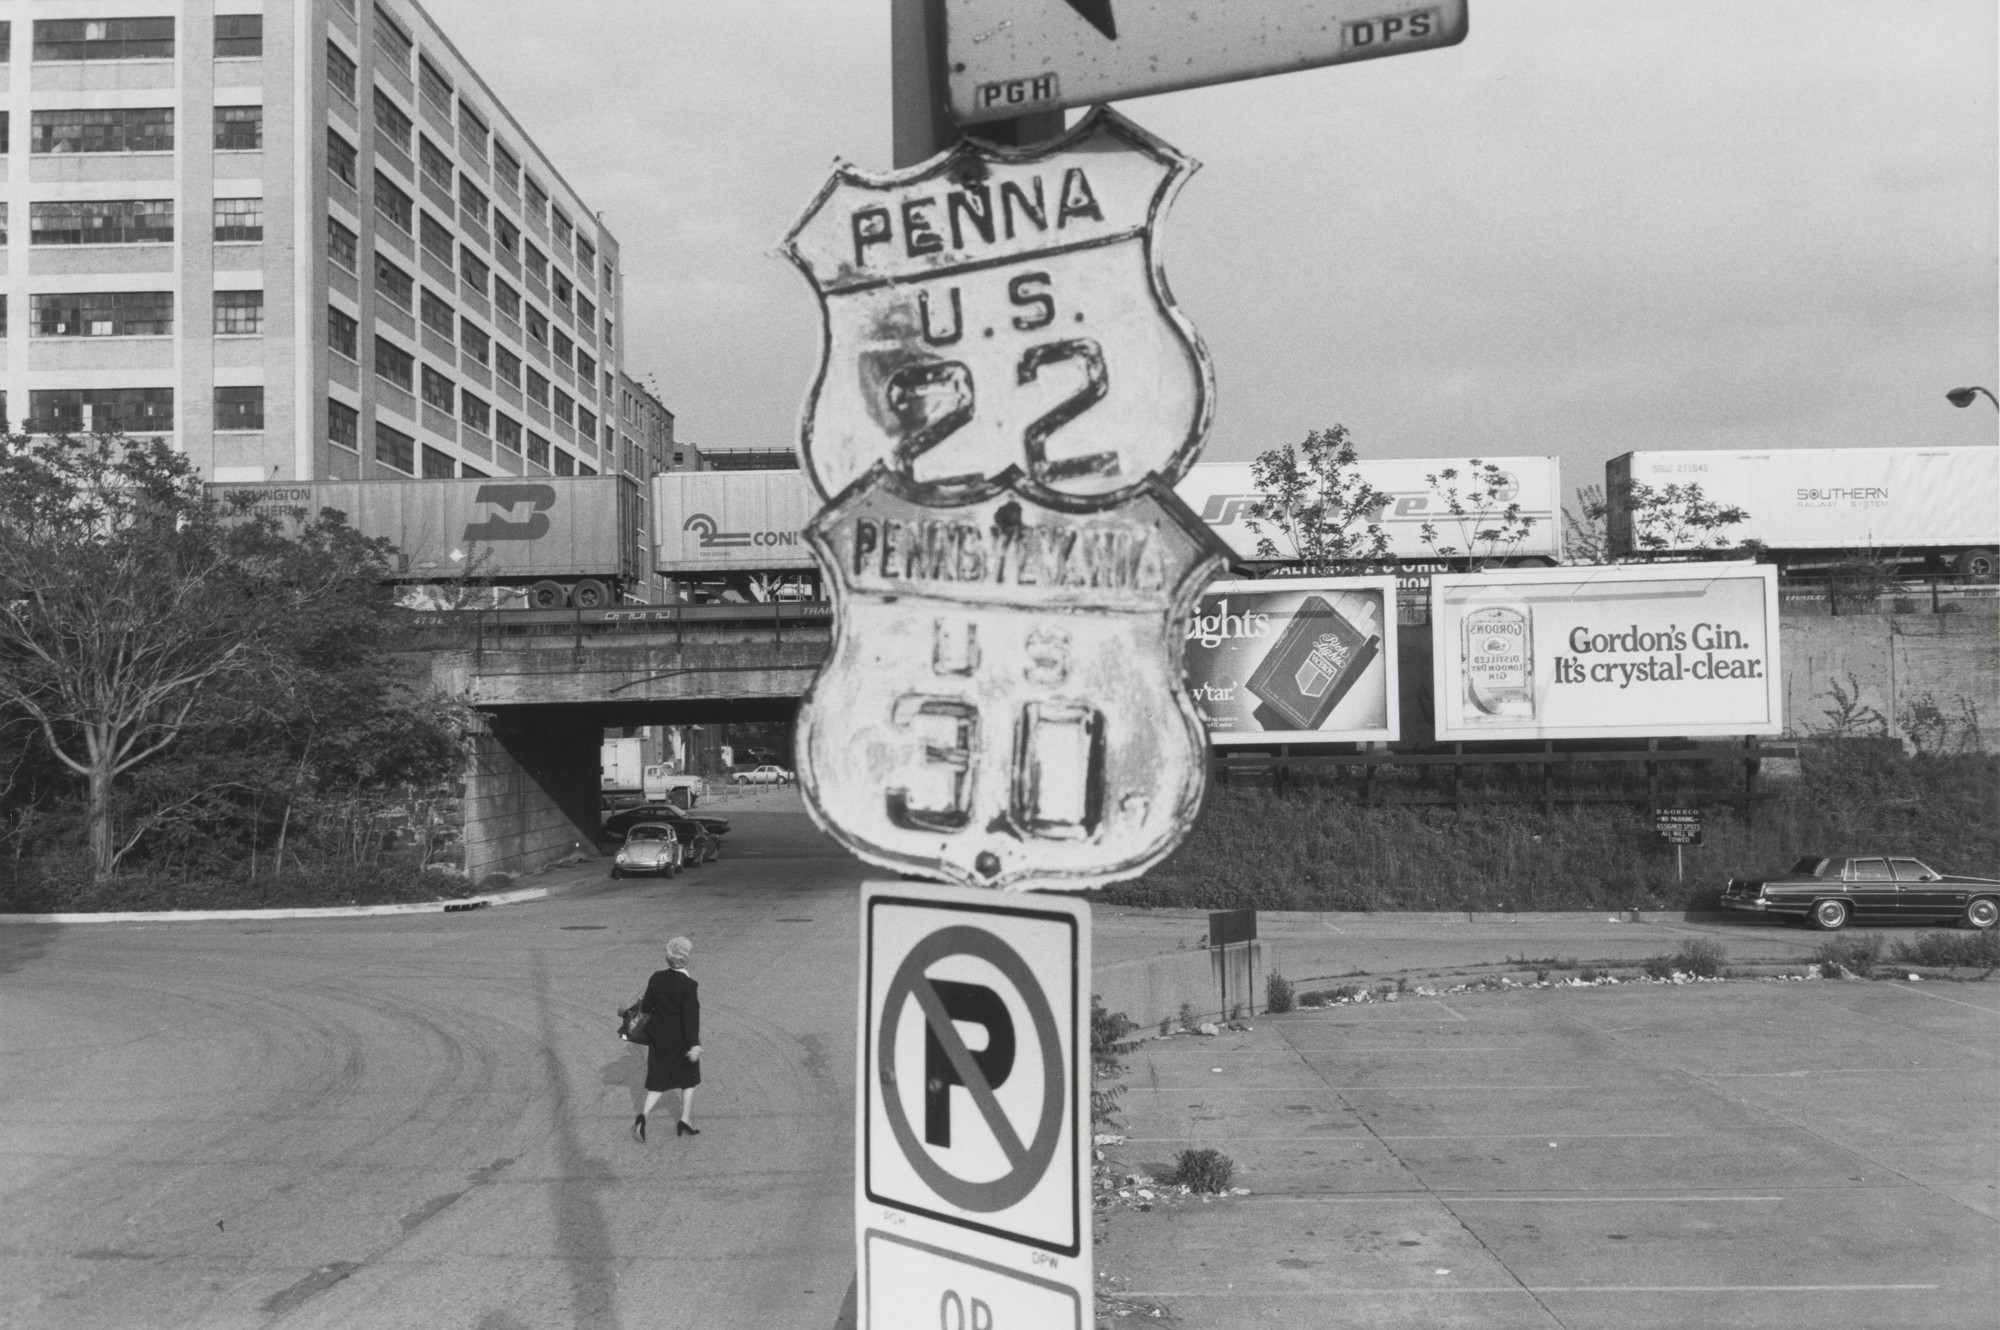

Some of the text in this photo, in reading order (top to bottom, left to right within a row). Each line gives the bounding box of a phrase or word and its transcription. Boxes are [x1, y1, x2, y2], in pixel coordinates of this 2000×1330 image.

[1352, 13, 1431, 48] DPS
[983, 78, 1052, 107] PGH
[851, 167, 1104, 267] PENNA
[918, 270, 1085, 348] U.S.
[886, 336, 1121, 484] 22
[223, 488, 311, 501] BINGTON
[1797, 487, 1889, 500] SOUTHERN
[220, 505, 300, 518] ORTHERN
[803, 607, 832, 616] TRAI
[1569, 623, 1749, 654] Gordon's Gin.
[1554, 652, 1763, 689] It's crystal-clear.
[886, 692, 1108, 844] 30
